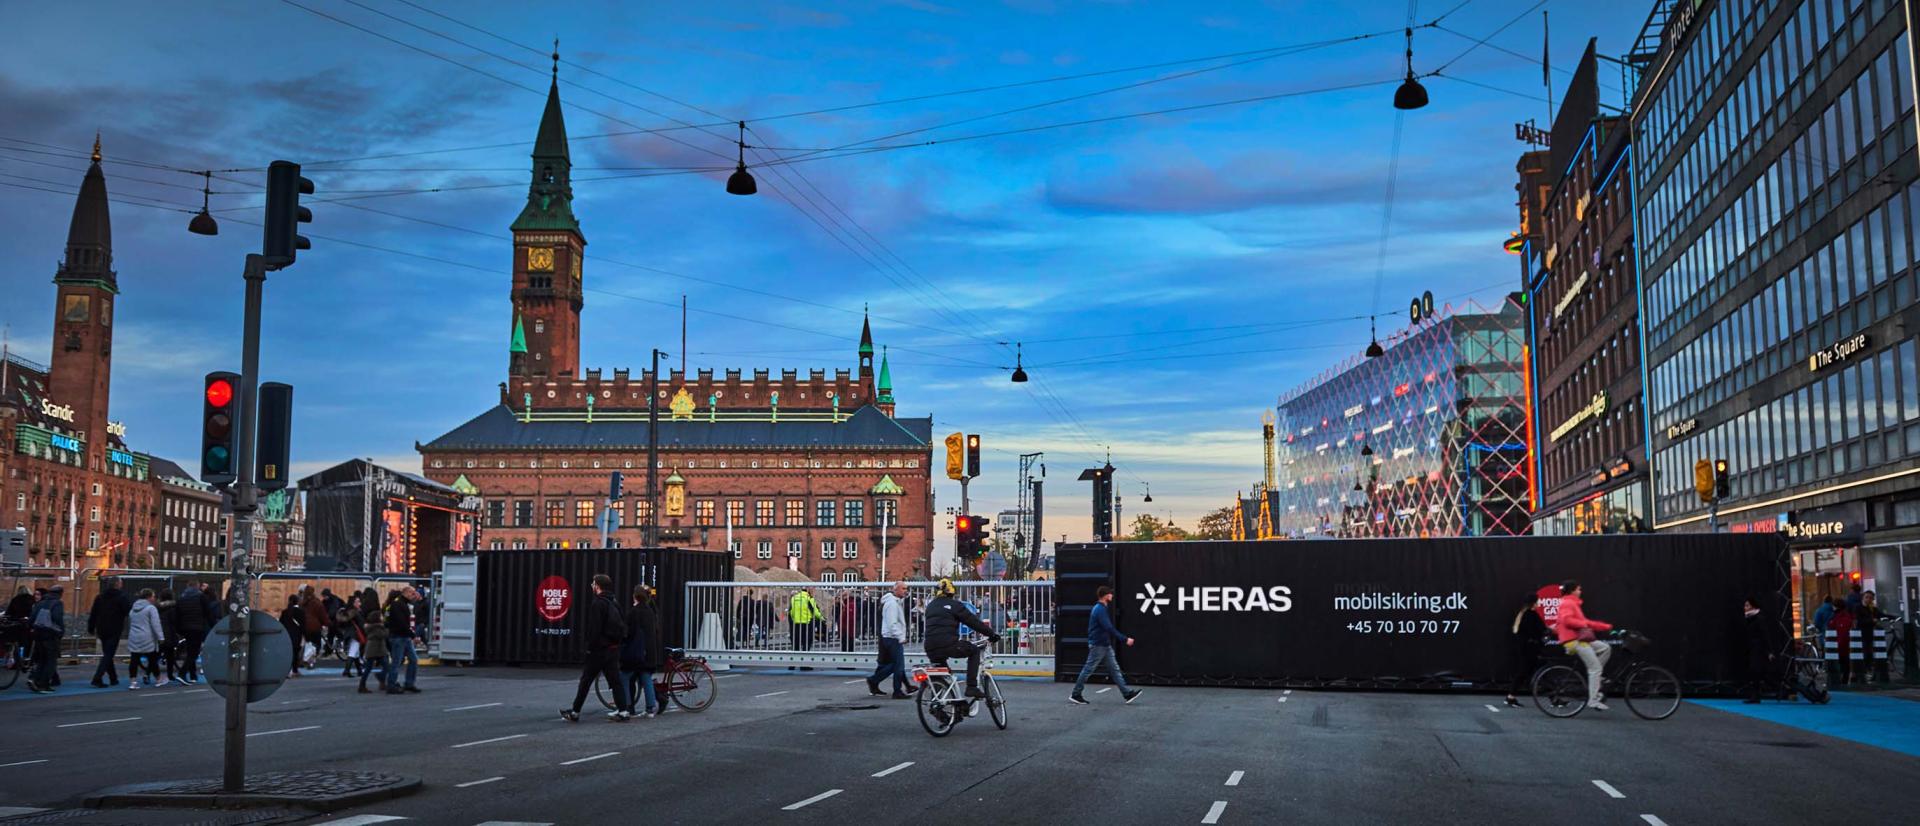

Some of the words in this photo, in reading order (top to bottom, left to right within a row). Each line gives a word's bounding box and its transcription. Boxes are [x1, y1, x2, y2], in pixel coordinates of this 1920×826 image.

[1670, 0, 1695, 49] Hotel
[1817, 351, 1833, 368] The
[1834, 334, 1865, 360] Square
[41, 398, 75, 422] Scandic
[1680, 418, 1695, 435] Square
[51, 434, 80, 452] PALACE
[111, 450, 134, 466] HOTEL
[1800, 521, 1844, 539] Square
[545, 597, 562, 606] GATE
[1178, 585, 1292, 612] HERAS
[1334, 592, 1468, 613] mobilsikring.dk
[1537, 598, 1561, 607] MOB
[1346, 620, 1372, 634] +45
[1376, 620, 1394, 634] 70
[1398, 620, 1416, 634] 10
[1420, 620, 1438, 634] 70
[1442, 620, 1460, 634] 77
